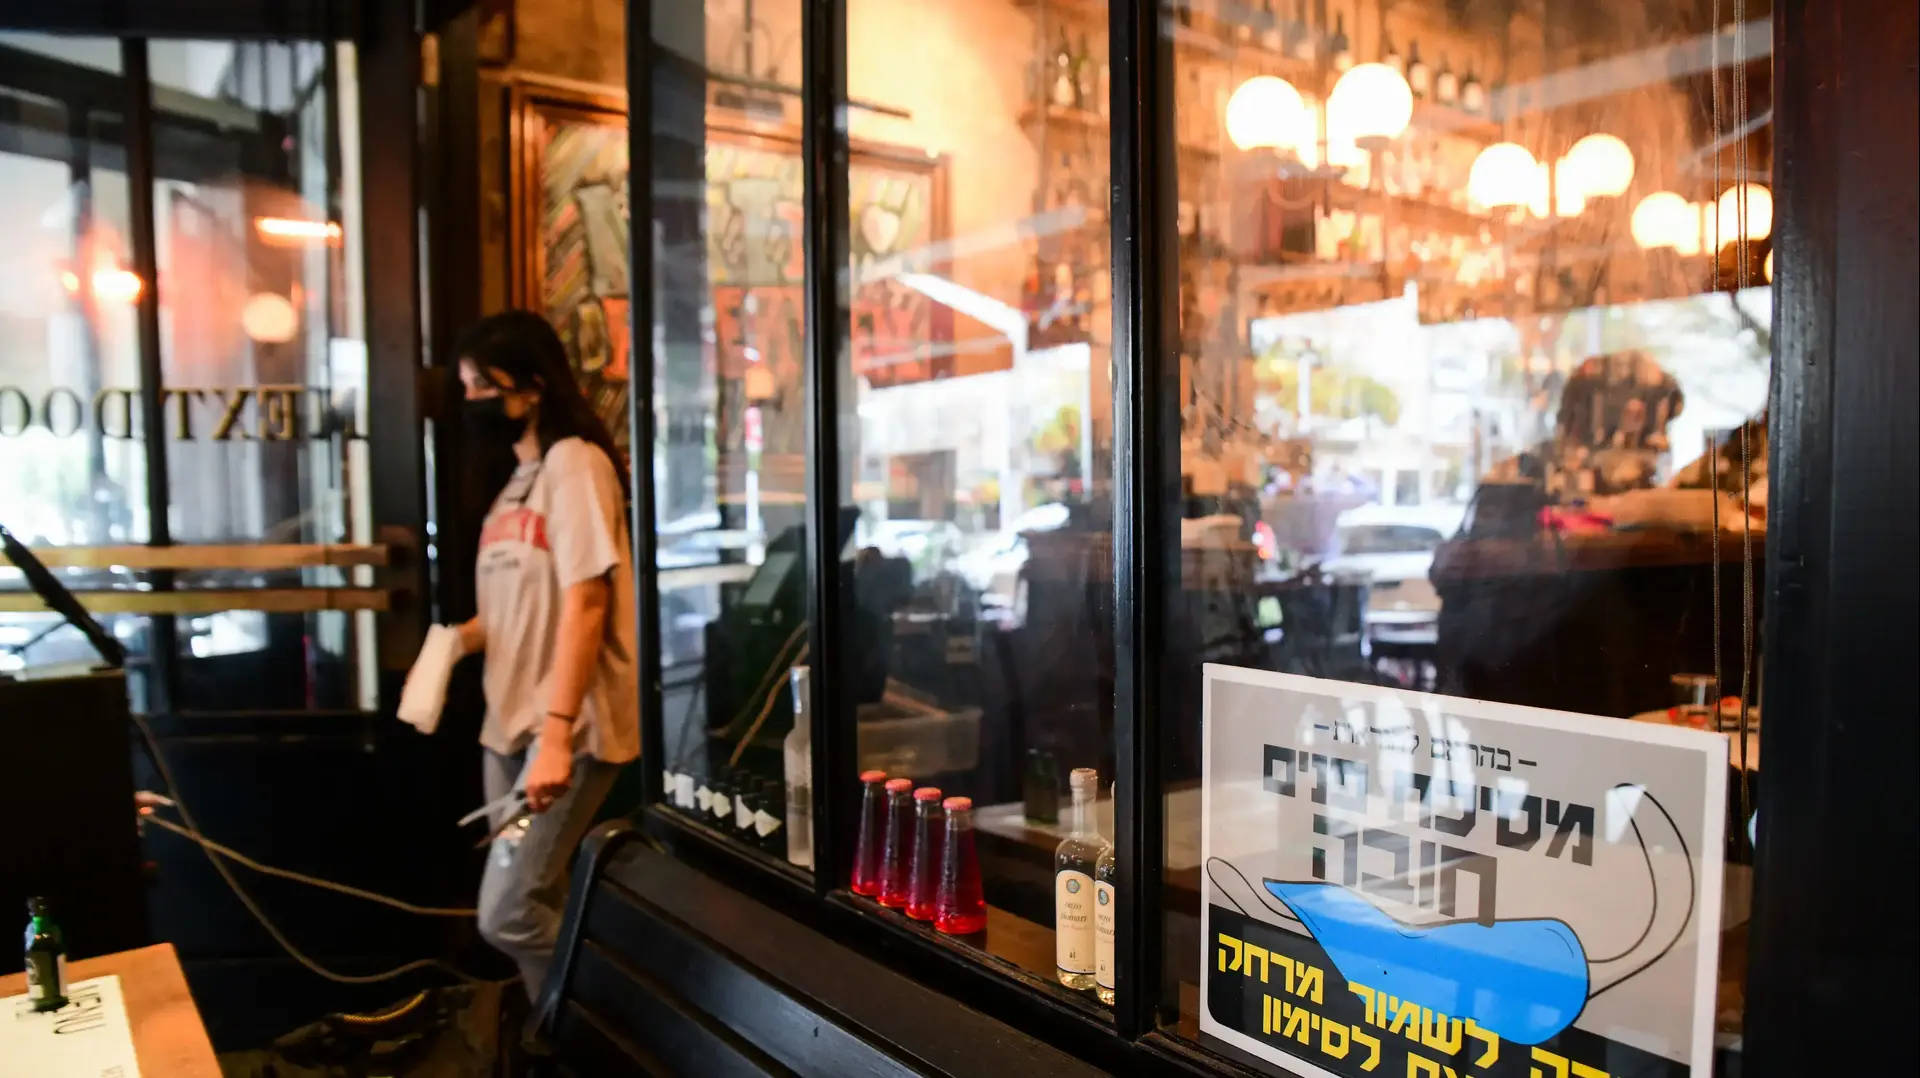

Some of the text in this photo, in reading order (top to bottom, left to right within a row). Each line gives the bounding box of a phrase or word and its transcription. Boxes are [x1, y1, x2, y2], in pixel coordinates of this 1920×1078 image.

[1263, 743, 1369, 815] פנים
[1311, 813, 1498, 928] חובה
[1218, 932, 1500, 1069] לשמור מרחק
[1262, 993, 1381, 1072] לסימון
